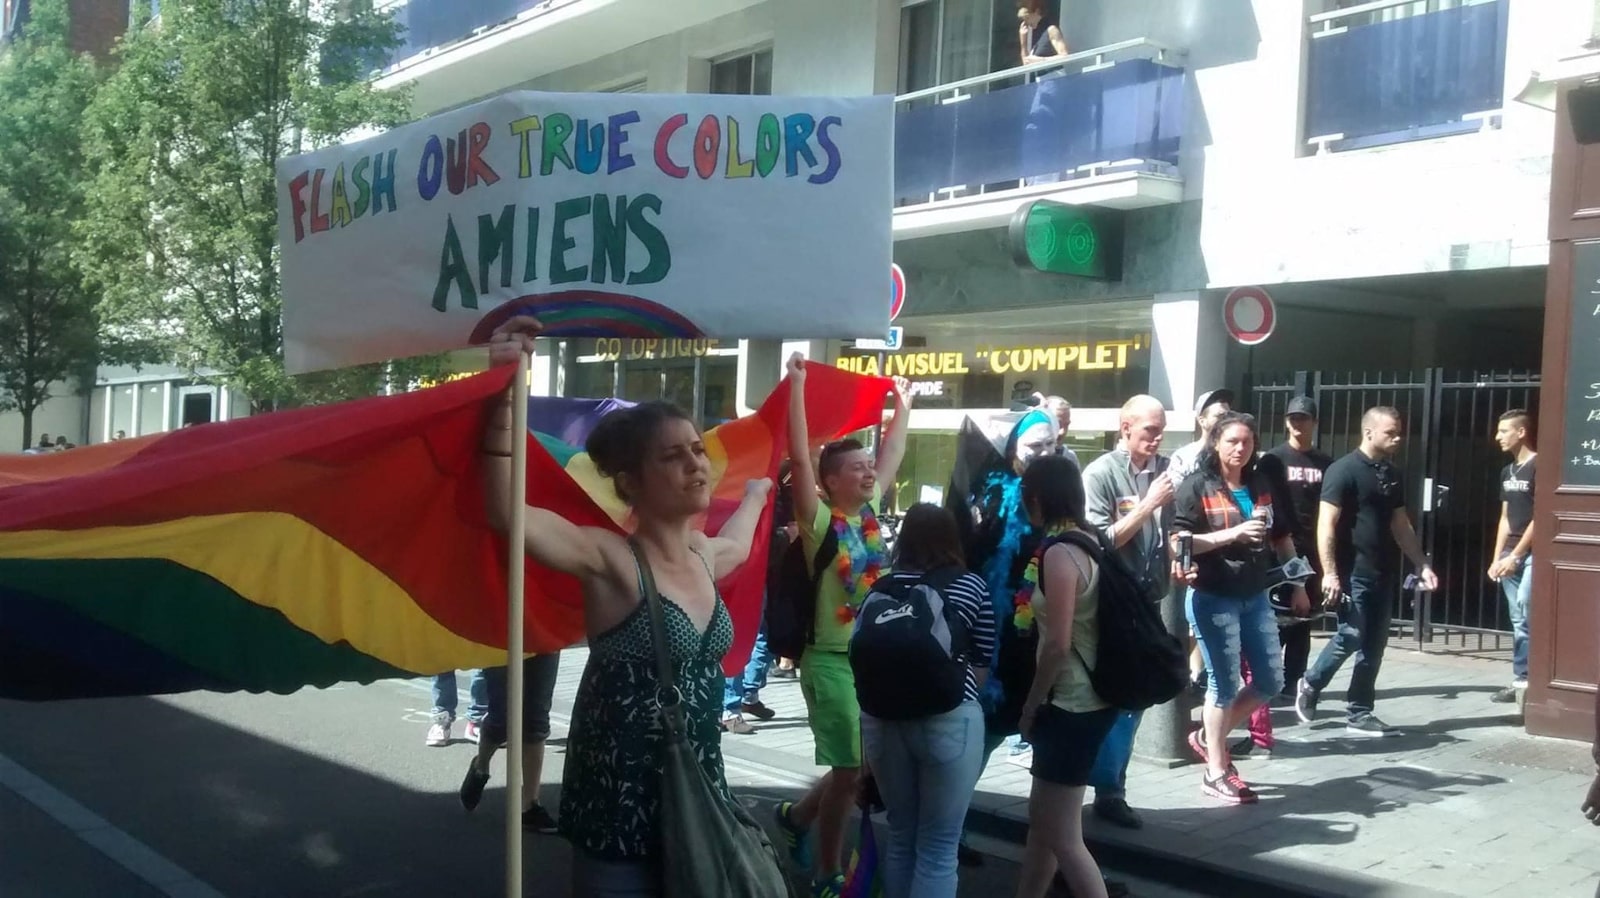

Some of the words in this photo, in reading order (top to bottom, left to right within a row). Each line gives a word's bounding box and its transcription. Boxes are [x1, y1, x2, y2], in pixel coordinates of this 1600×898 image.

[288, 148, 398, 244] FLASH
[416, 121, 501, 201] OUR
[509, 110, 641, 178] TRUE
[653, 112, 842, 185] COLORS
[432, 193, 672, 313] AMIENS
[895, 352, 969, 375] VISUEL
